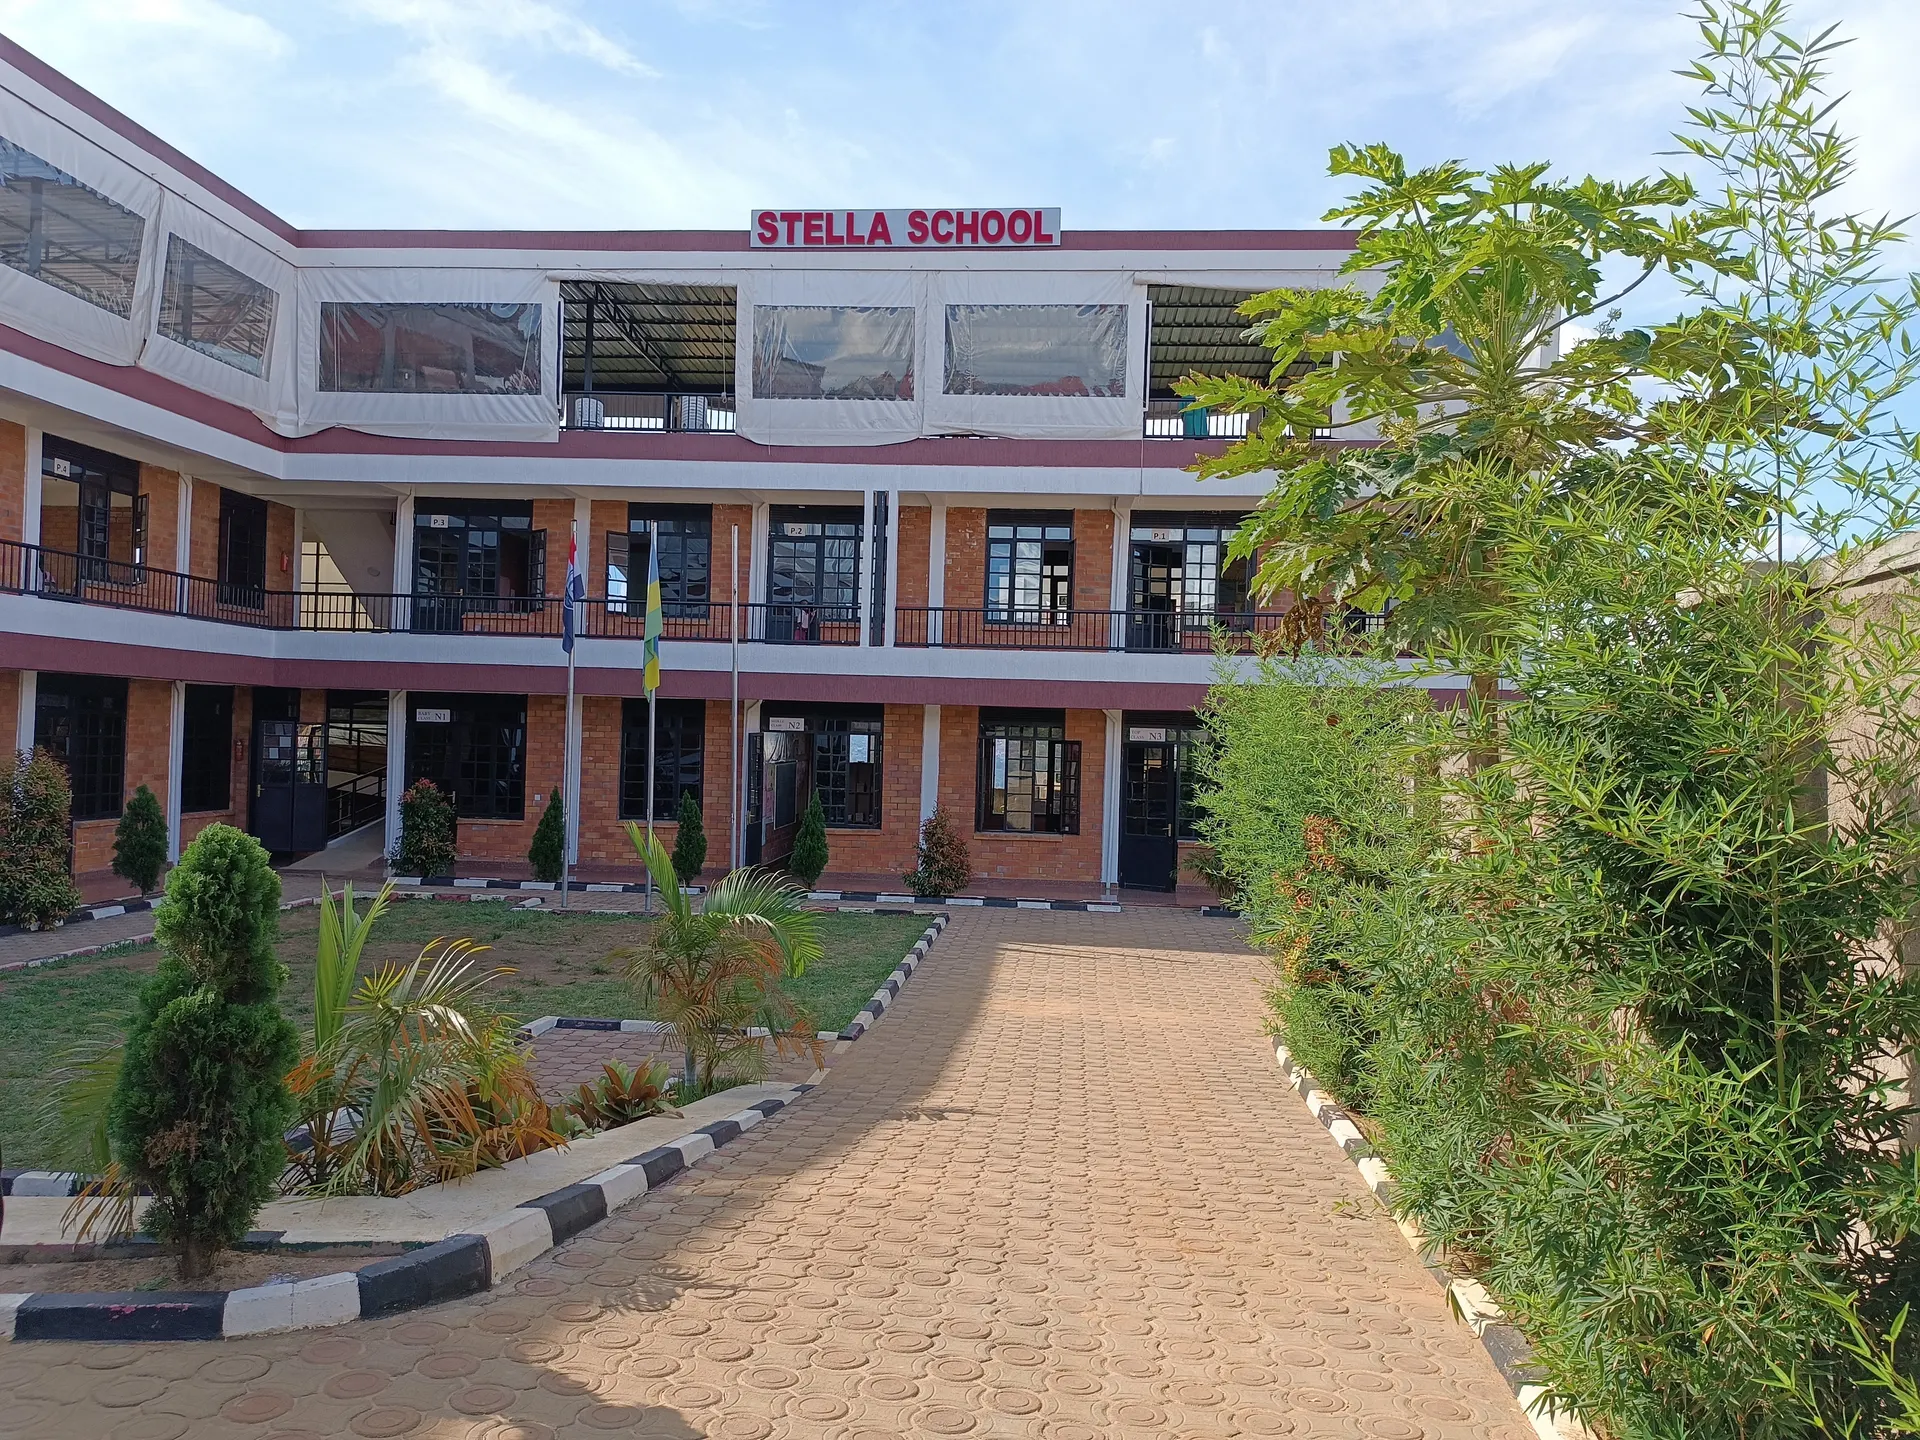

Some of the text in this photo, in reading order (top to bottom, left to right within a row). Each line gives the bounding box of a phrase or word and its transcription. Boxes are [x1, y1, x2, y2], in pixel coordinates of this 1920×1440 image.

[757, 209, 1054, 246] STELLA SCHOOL
[56, 463, 67, 473] P.4
[433, 518, 445, 527] P.3
[790, 527, 803, 535] P.2
[1153, 532, 1166, 540] P.1
[434, 712, 447, 721] N1
[788, 721, 801, 730] N2
[1149, 732, 1162, 741] N3
